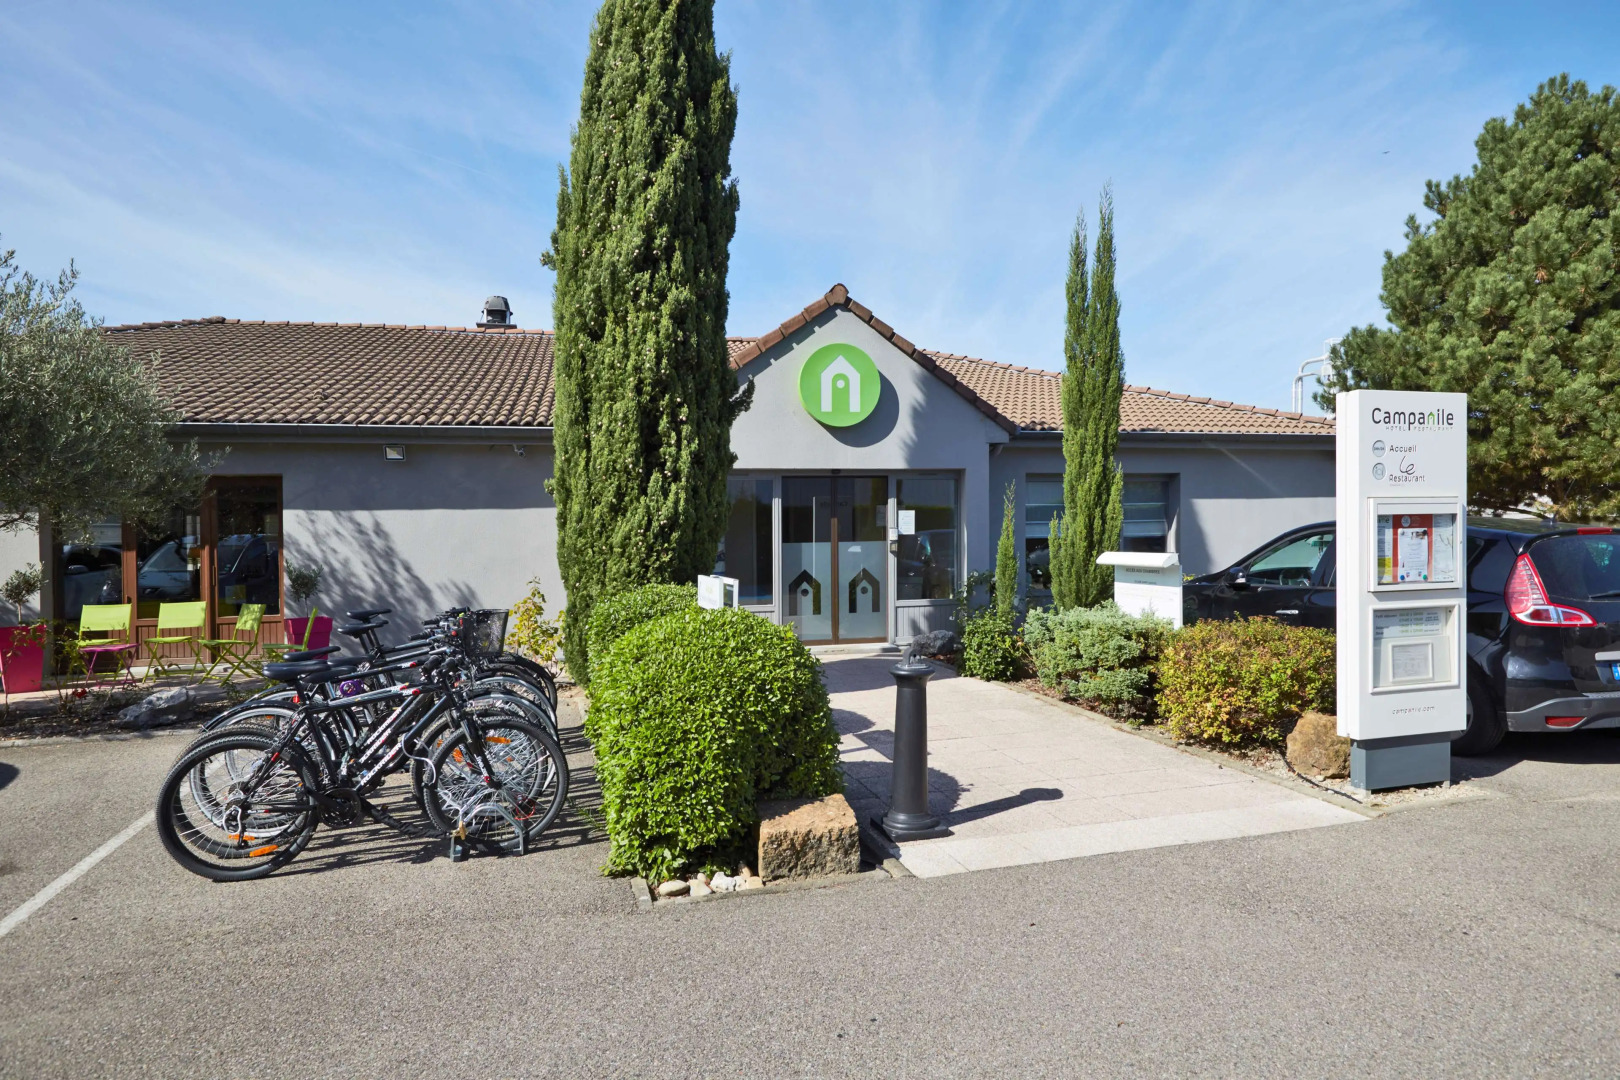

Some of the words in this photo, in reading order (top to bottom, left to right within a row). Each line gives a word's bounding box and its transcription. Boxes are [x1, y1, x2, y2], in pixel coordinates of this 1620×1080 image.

[1372, 407, 1454, 431] Campanile
[1389, 445, 1417, 453] Accueil
[1388, 474, 1425, 483] Restaurant
